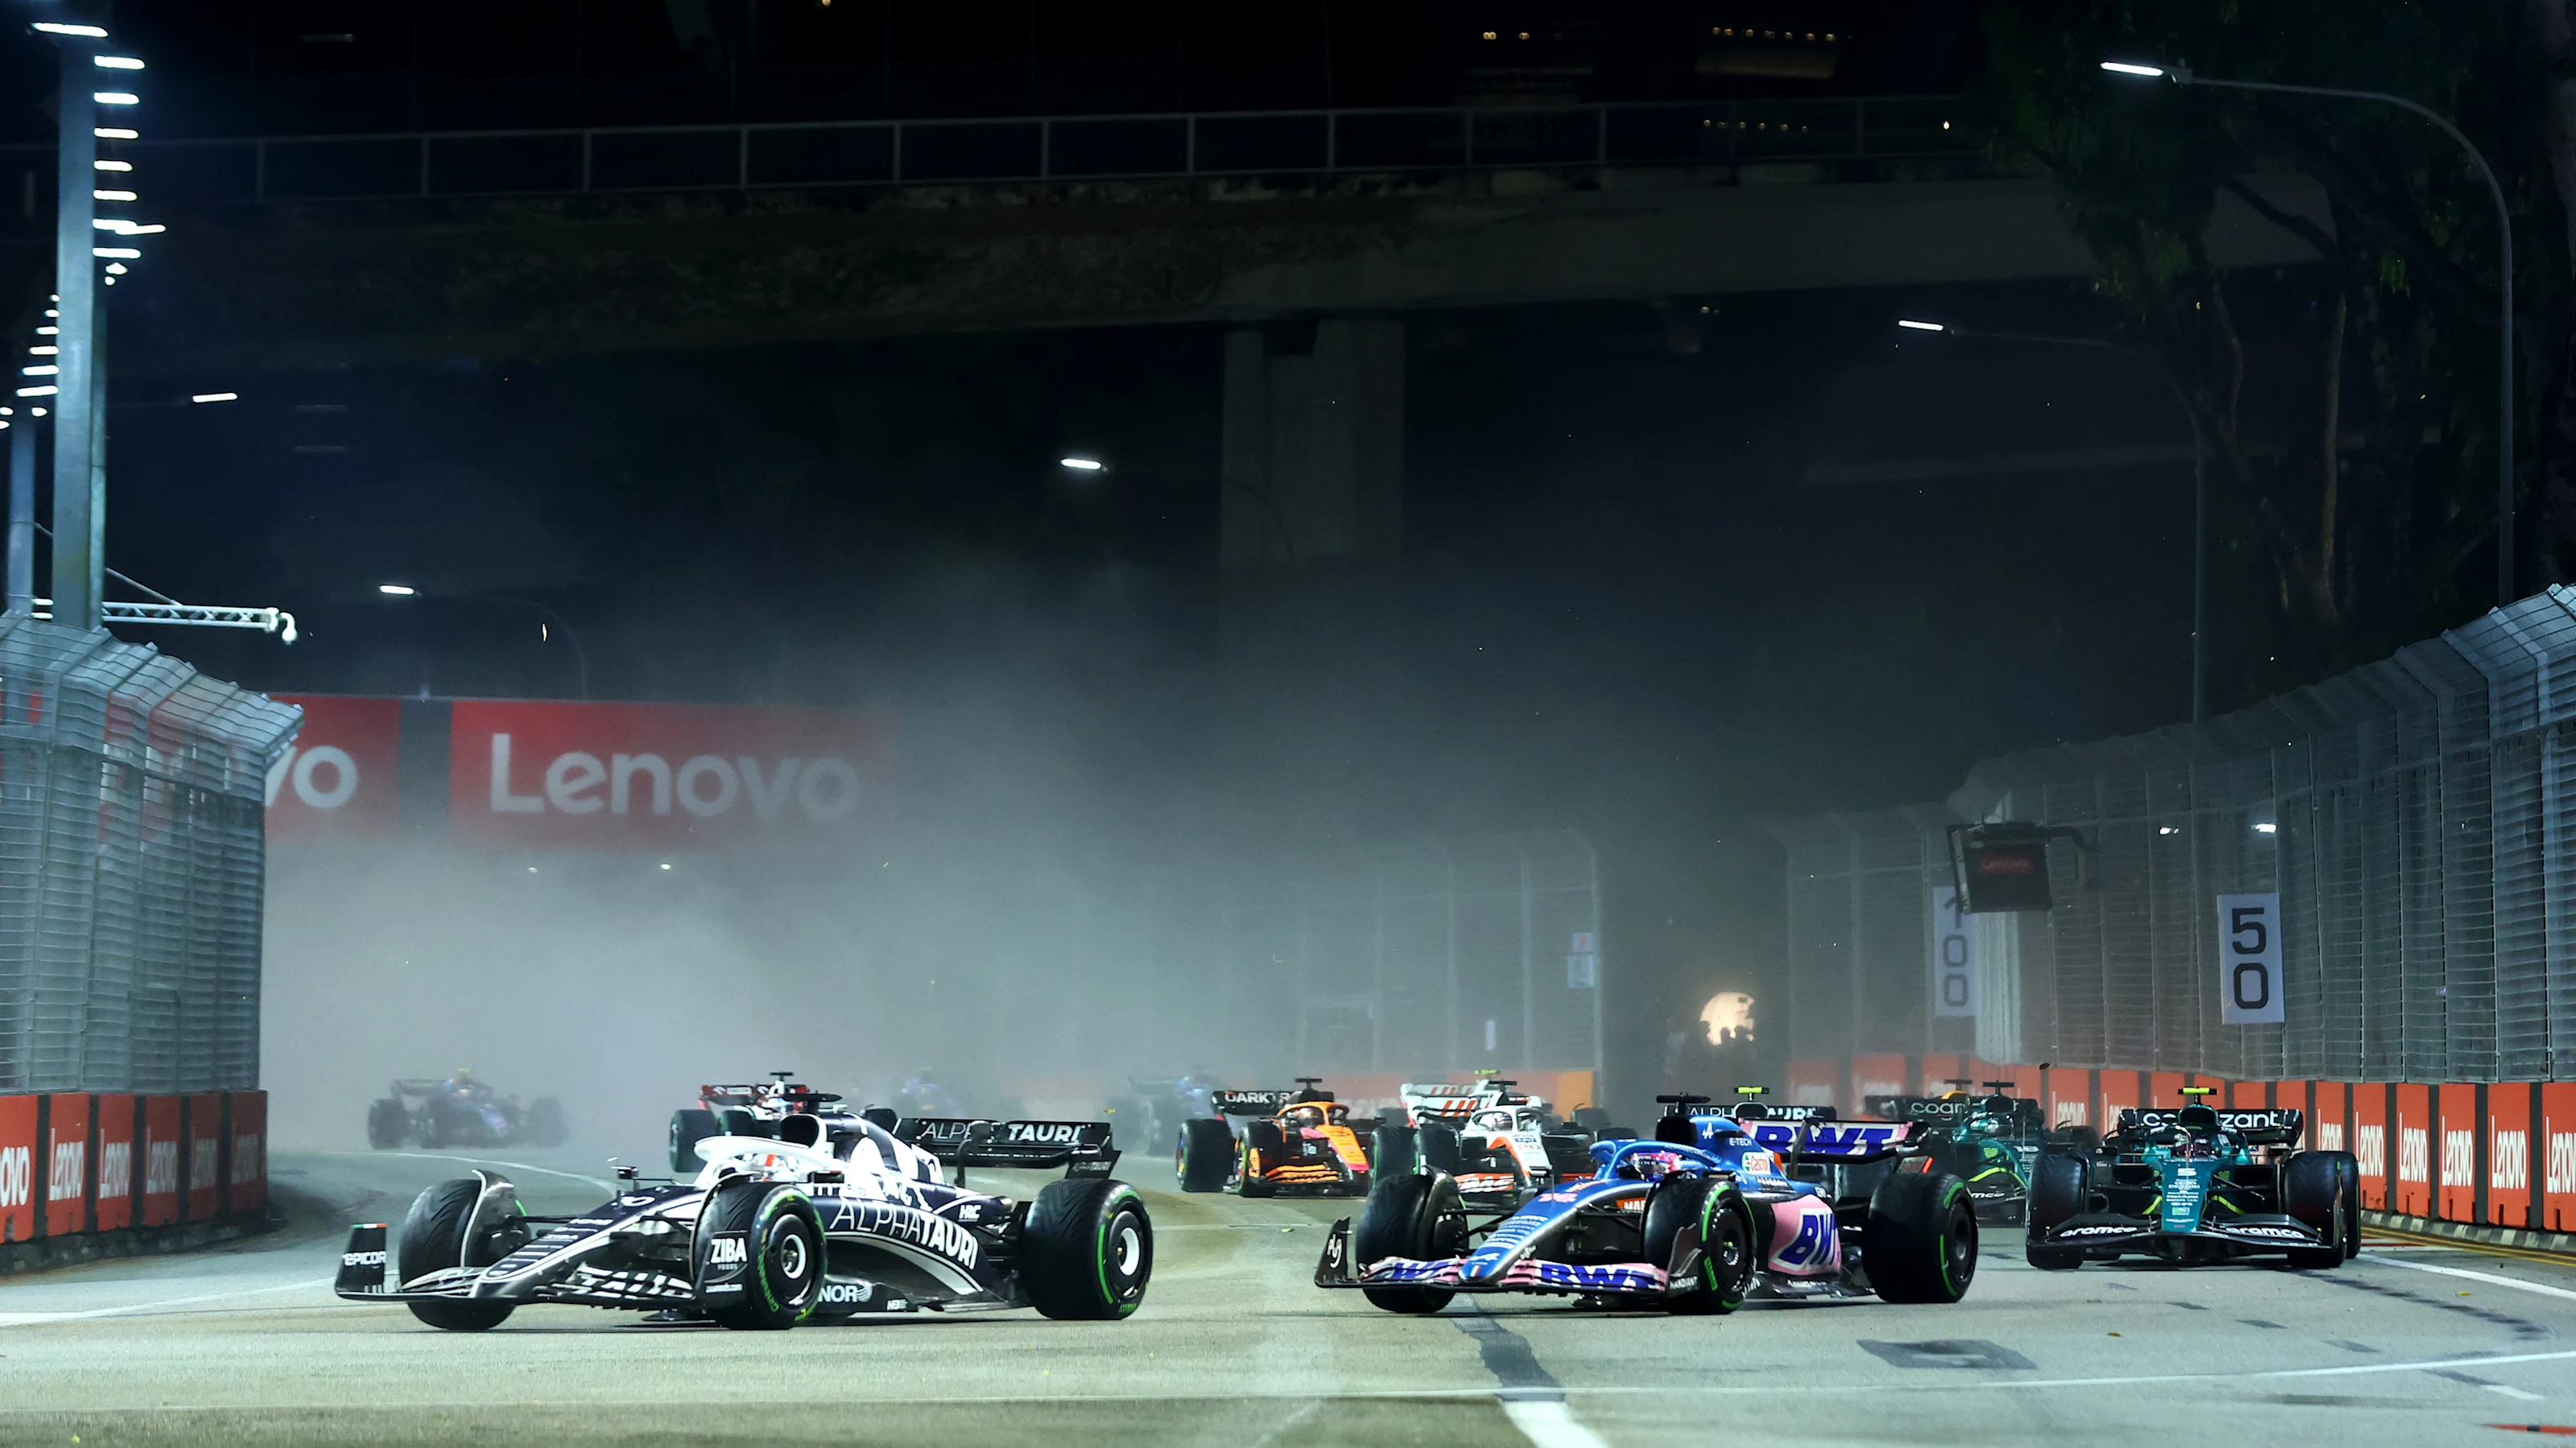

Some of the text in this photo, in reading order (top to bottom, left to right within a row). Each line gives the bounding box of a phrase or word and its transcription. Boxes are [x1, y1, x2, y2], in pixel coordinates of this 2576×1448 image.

[492, 733, 860, 816] Lenovo
[2231, 907, 2268, 1009] 50
[49, 1128, 84, 1201] Lenovo
[100, 1128, 131, 1198] Lenovo
[1007, 1124, 1083, 1142] TAURI
[1728, 1137, 1752, 1146] E-TECH
[1752, 1124, 1895, 1154] BWT
[2355, 1111, 2385, 1178] Lenovo
[2399, 1112, 2428, 1183] Lenovo
[2442, 1115, 2473, 1187] Lenovo
[2491, 1115, 2527, 1189] Lenovo
[711, 1237, 747, 1264] ZIBA
[828, 1197, 979, 1271] ALPHATAURI
[2059, 1226, 2138, 1238] aramco
[2225, 1227, 2306, 1240] aramco
